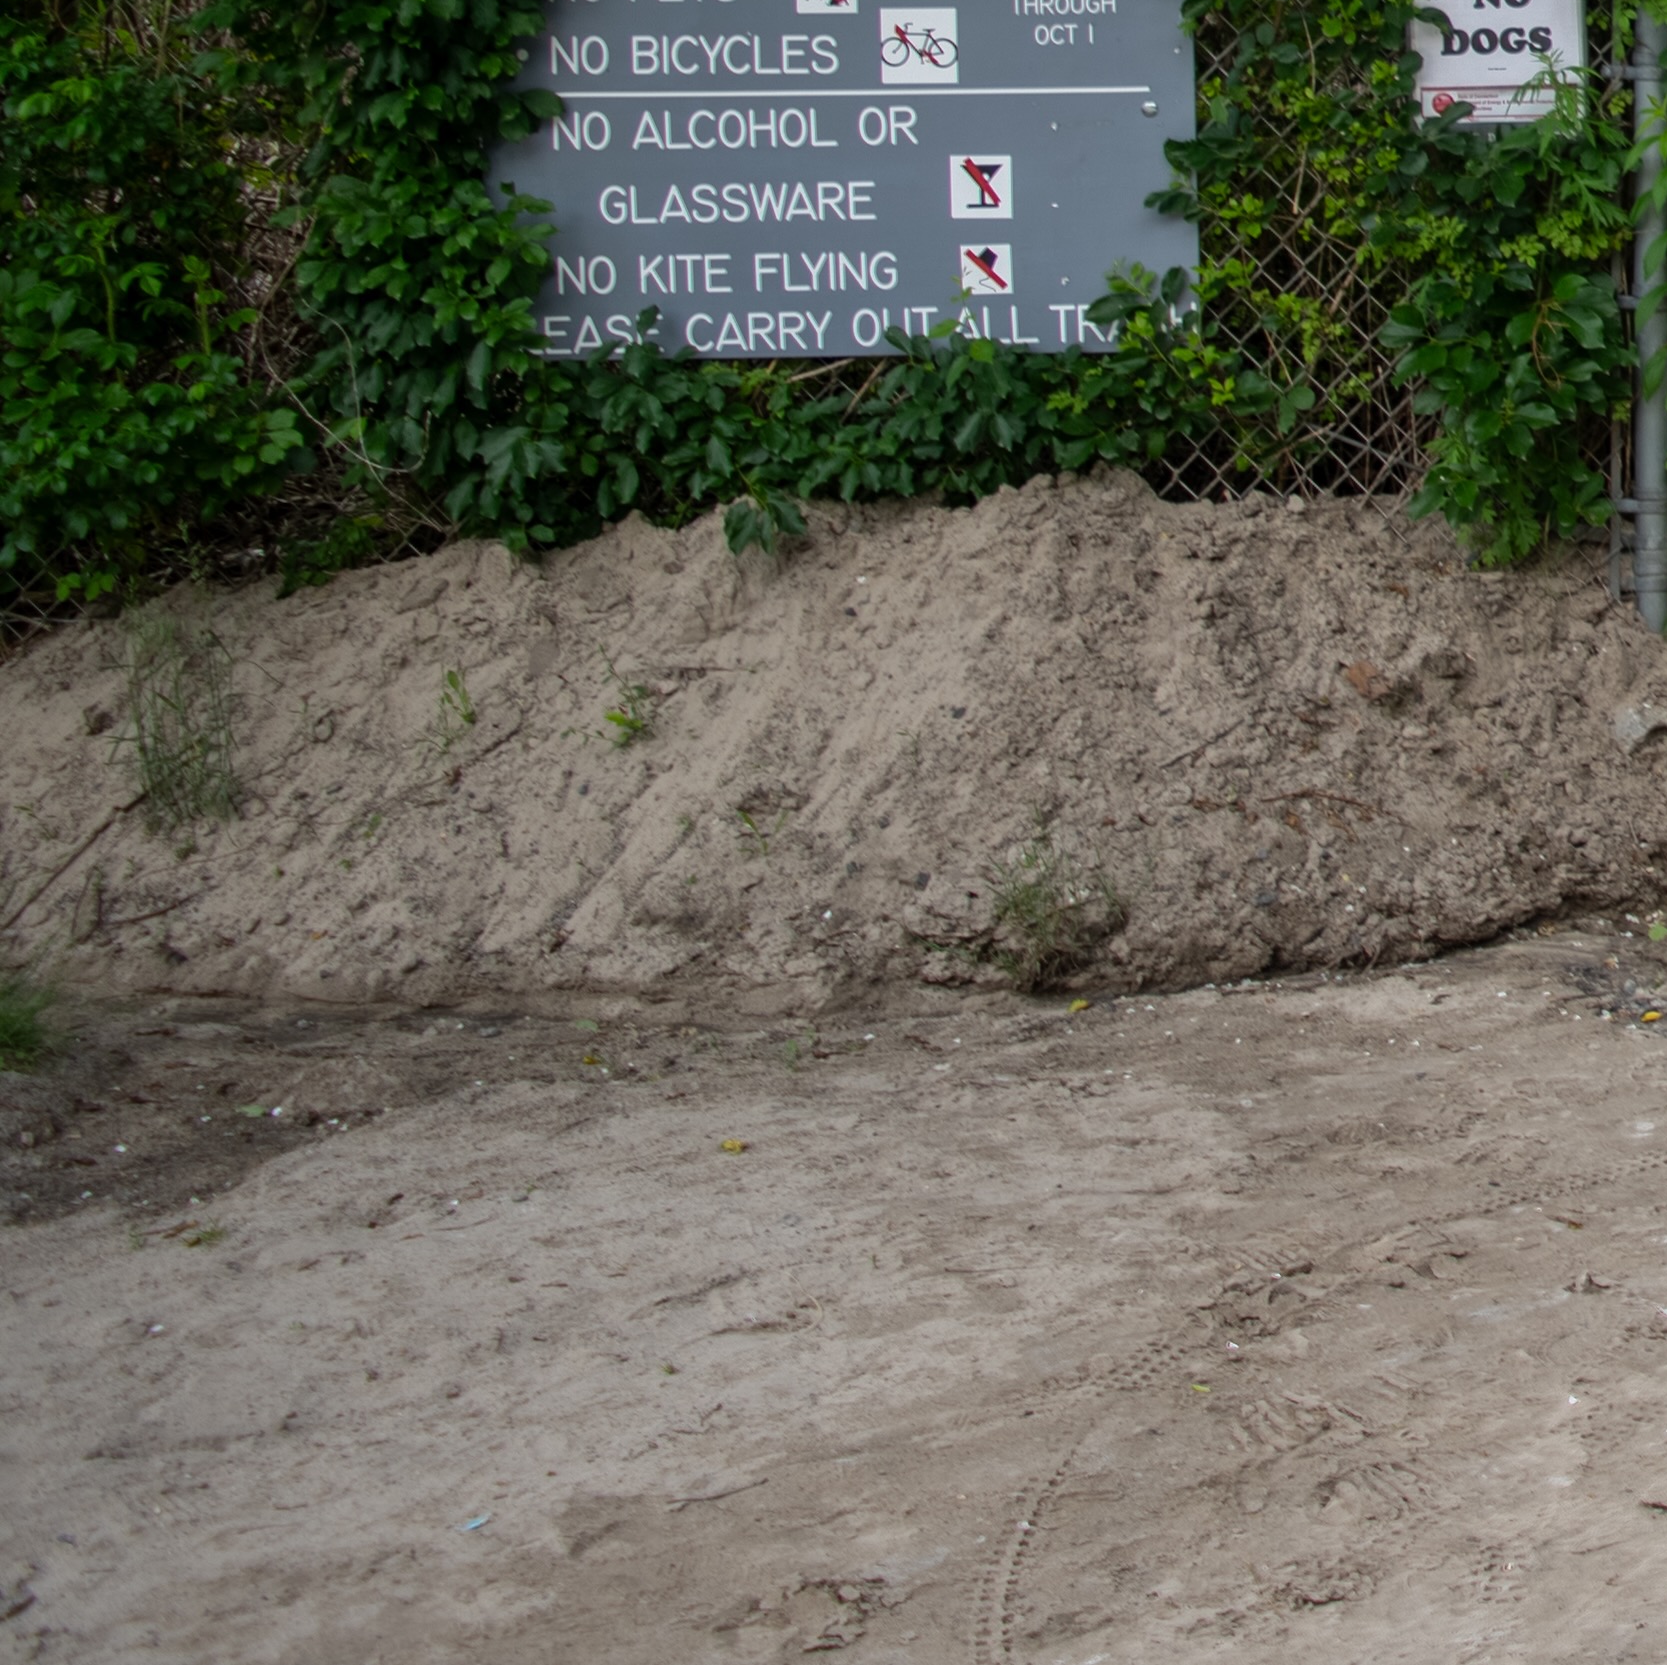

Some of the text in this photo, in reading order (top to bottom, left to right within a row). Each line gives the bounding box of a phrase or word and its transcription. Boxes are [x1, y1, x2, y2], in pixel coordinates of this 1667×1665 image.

[551, 34, 840, 75] NO BICYCLES
[1034, 23, 1079, 45] OCT
[1441, 26, 1553, 56] DOGS
[552, 105, 919, 151] NO ALCOHOL OR
[599, 181, 878, 224] GLASSWARE
[556, 251, 899, 295] NO KITE FLYING
[685, 310, 833, 352] CARRY
[852, 306, 939, 348] OUT
[955, 304, 1041, 344] ALL
